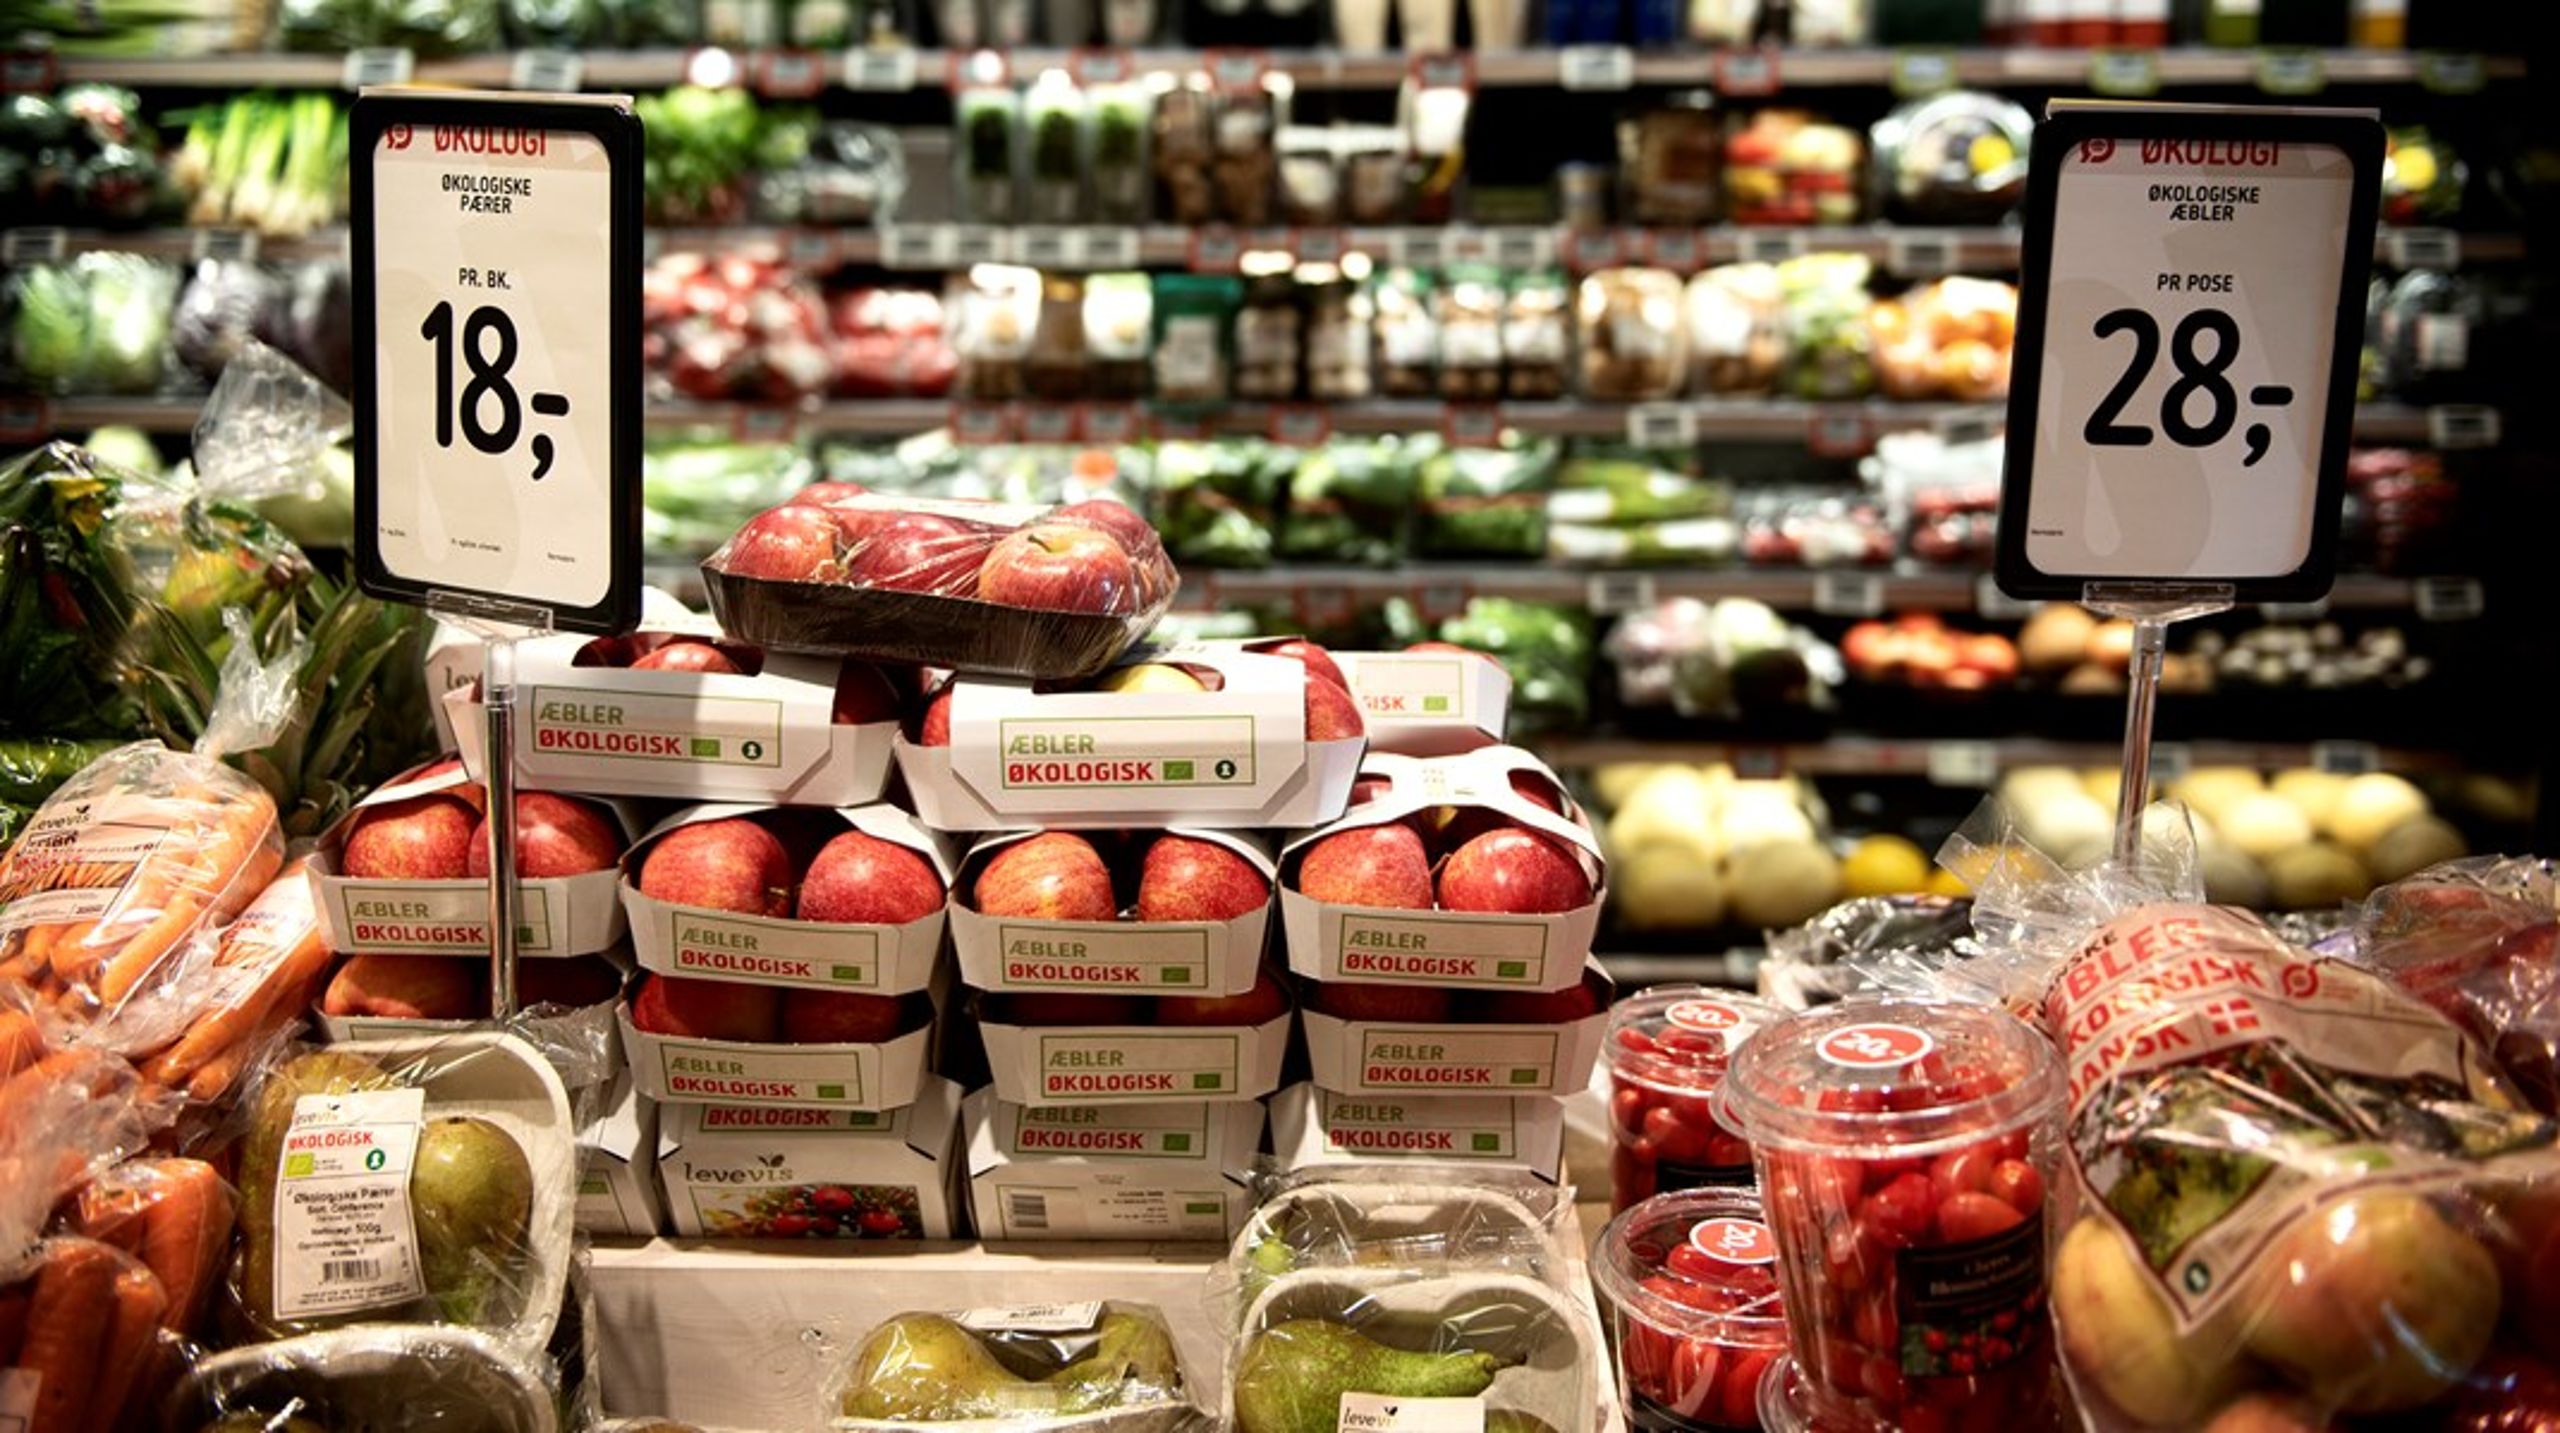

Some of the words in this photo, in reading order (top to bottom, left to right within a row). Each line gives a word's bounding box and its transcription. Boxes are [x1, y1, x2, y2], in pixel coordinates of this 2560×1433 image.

[434, 125, 547, 157] ØKOLOGI
[2140, 139, 2280, 167] ØKOLOGI
[442, 174, 532, 197] ØKOLOGISKE
[2148, 184, 2261, 204] ØKOLOGISKE
[460, 195, 513, 214] PÆRER
[2169, 203, 2236, 222] ÆBLER
[459, 267, 483, 288] PR.
[487, 269, 512, 291] BK.
[2157, 273, 2181, 292] PR
[2186, 274, 2234, 293] POSE
[421, 301, 570, 481] 18,-
[2083, 308, 2294, 467] 28,-
[539, 702, 625, 727] ÆBLER
[539, 729, 682, 756] ØKOLOGISK
[1007, 733, 1095, 755] ÆBLER
[1008, 761, 1154, 783] ØKOLOGISK
[354, 901, 430, 920] ÆBLER
[356, 925, 485, 944] ØKOLOGISK
[681, 927, 759, 952] ÆBLER
[1348, 929, 1427, 950] ÆBLER
[1008, 938, 1087, 959] ÆBLER
[681, 949, 812, 978] ØKOLOGISK
[1008, 962, 1140, 983] ØKOLOGISK
[1345, 953, 1476, 976] ØKOLOGISK
[1048, 1049, 1124, 1069] ÆBLER
[1368, 1043, 1444, 1062] ÆBLER
[670, 1055, 744, 1076] ÆBLER
[1367, 1066, 1491, 1085] ØKOLOGISK
[672, 1077, 798, 1099] ØKOLOGISK
[1047, 1072, 1174, 1092] ØKOLOGISK
[708, 1108, 832, 1128] ØKOLOGISK
[1024, 1104, 1099, 1125] ÆBLER
[1331, 1103, 1404, 1123] ÆBLER
[288, 1131, 374, 1150] ØKOLOGISK
[1021, 1128, 1144, 1150] ØKOLOGISK
[1330, 1127, 1453, 1150] ØKOLOGISK
[684, 1163, 794, 1184] levevis
